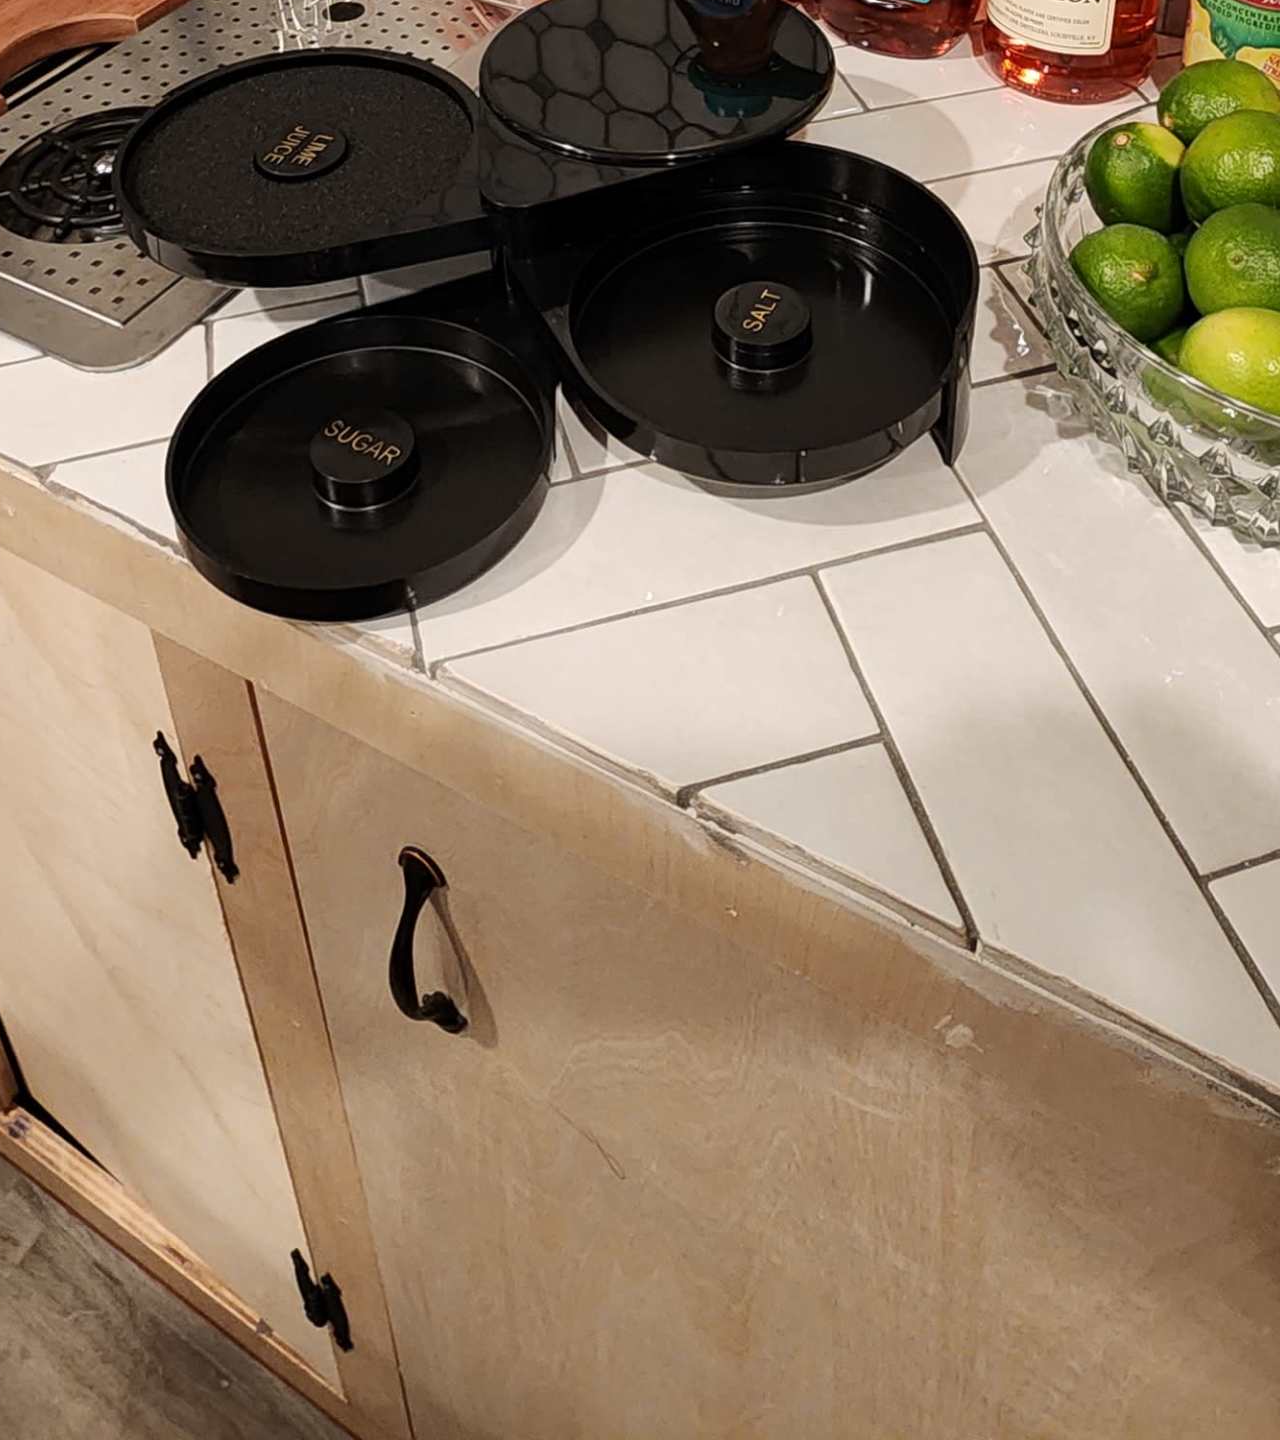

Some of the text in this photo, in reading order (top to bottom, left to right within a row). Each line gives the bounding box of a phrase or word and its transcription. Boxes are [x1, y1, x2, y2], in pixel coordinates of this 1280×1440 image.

[263, 124, 311, 165] JUICE
[289, 133, 335, 166] LIME
[742, 288, 781, 332] SALT
[324, 419, 401, 466] SUGAR
